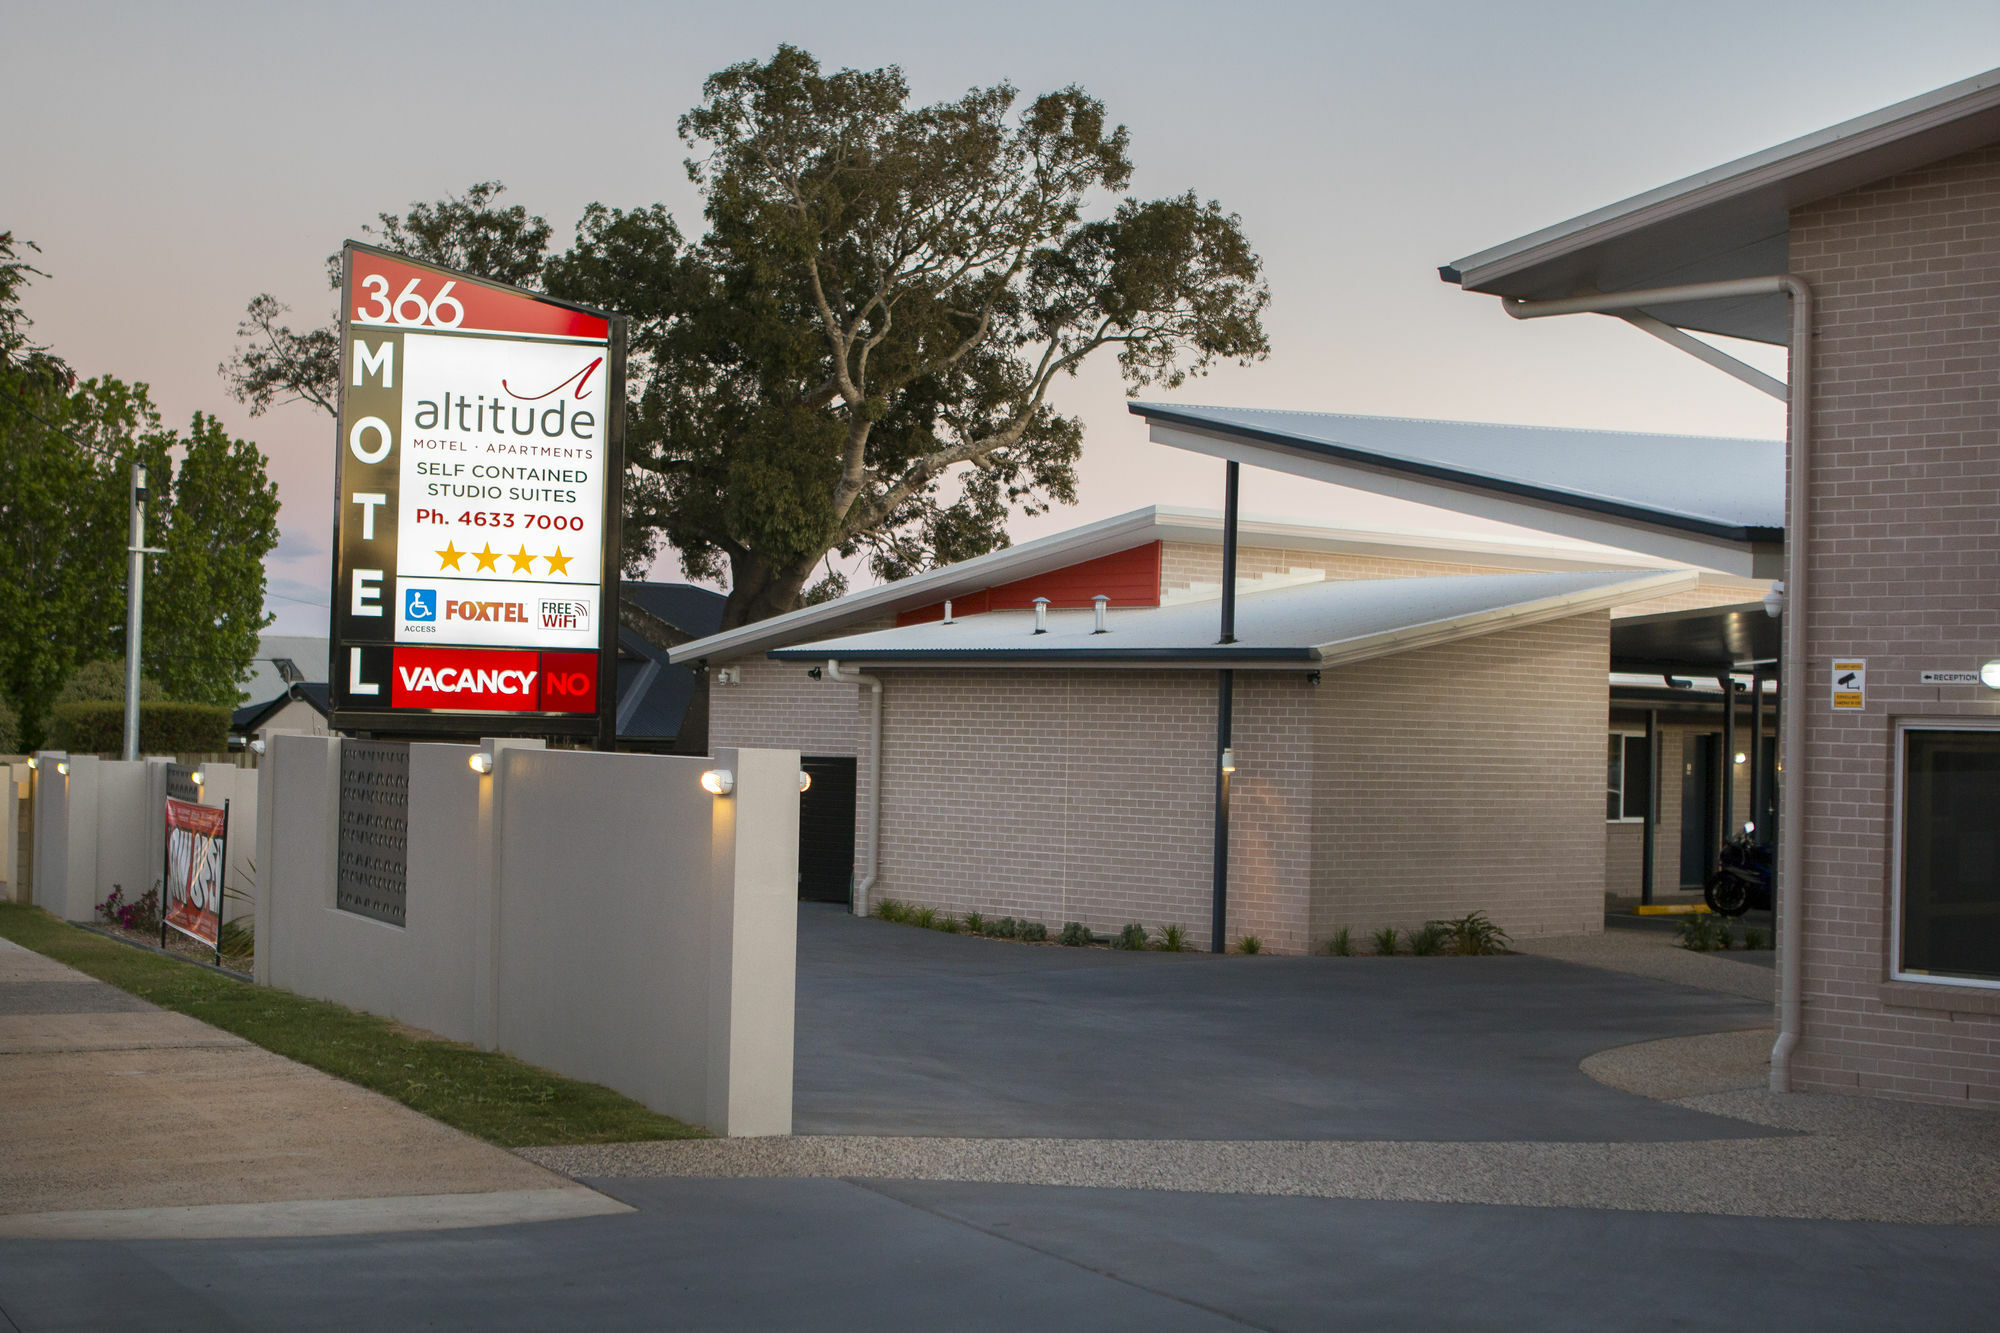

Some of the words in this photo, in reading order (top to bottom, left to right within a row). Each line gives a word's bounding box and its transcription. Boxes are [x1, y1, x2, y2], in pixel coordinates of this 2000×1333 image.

[357, 274, 465, 329] 366
[414, 391, 595, 440] altitude
[413, 439, 468, 452] MOTEL
[486, 443, 593, 460] APARTMENTS
[416, 462, 465, 478] SELF
[472, 465, 588, 483] CONTAINED
[427, 483, 502, 499] STUDIO
[509, 487, 577, 503] SUITES
[349, 339, 394, 695] MOTEL
[416, 508, 450, 525] Ph.
[458, 511, 515, 528] 4633
[524, 514, 584, 531] 7000
[446, 600, 529, 623] FOXTEL
[541, 602, 572, 615] FREE
[404, 625, 436, 633] ACCESS
[542, 614, 577, 629] WiFi
[399, 666, 538, 695] VACANCY
[546, 672, 590, 696] NO
[1933, 673, 1978, 682] RECEPTION
